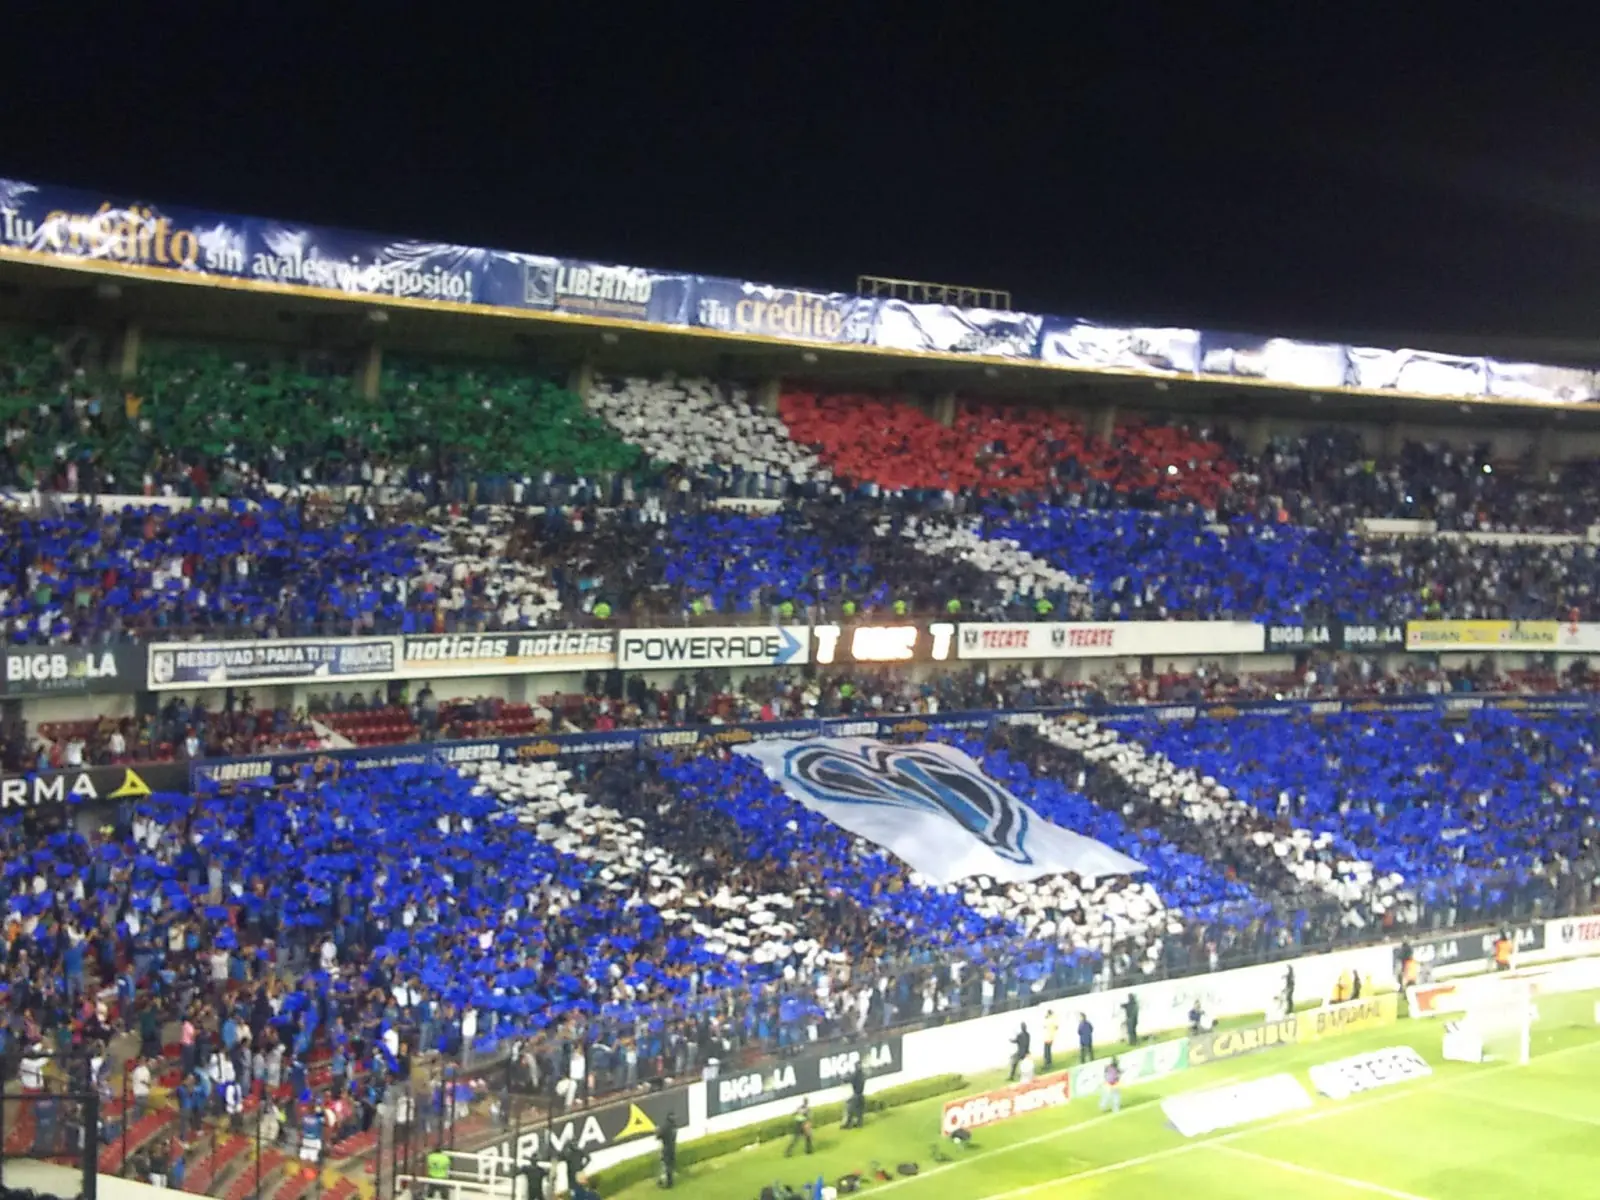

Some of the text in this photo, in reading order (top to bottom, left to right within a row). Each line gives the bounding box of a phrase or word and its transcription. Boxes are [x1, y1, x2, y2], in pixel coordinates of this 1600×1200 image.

[556, 265, 652, 303] LIBERTAD
[735, 290, 843, 338] crédito
[407, 637, 509, 661] noticias
[518, 632, 613, 656] noticias
[624, 635, 782, 662] POWERADE
[1, 772, 98, 808] RMA
